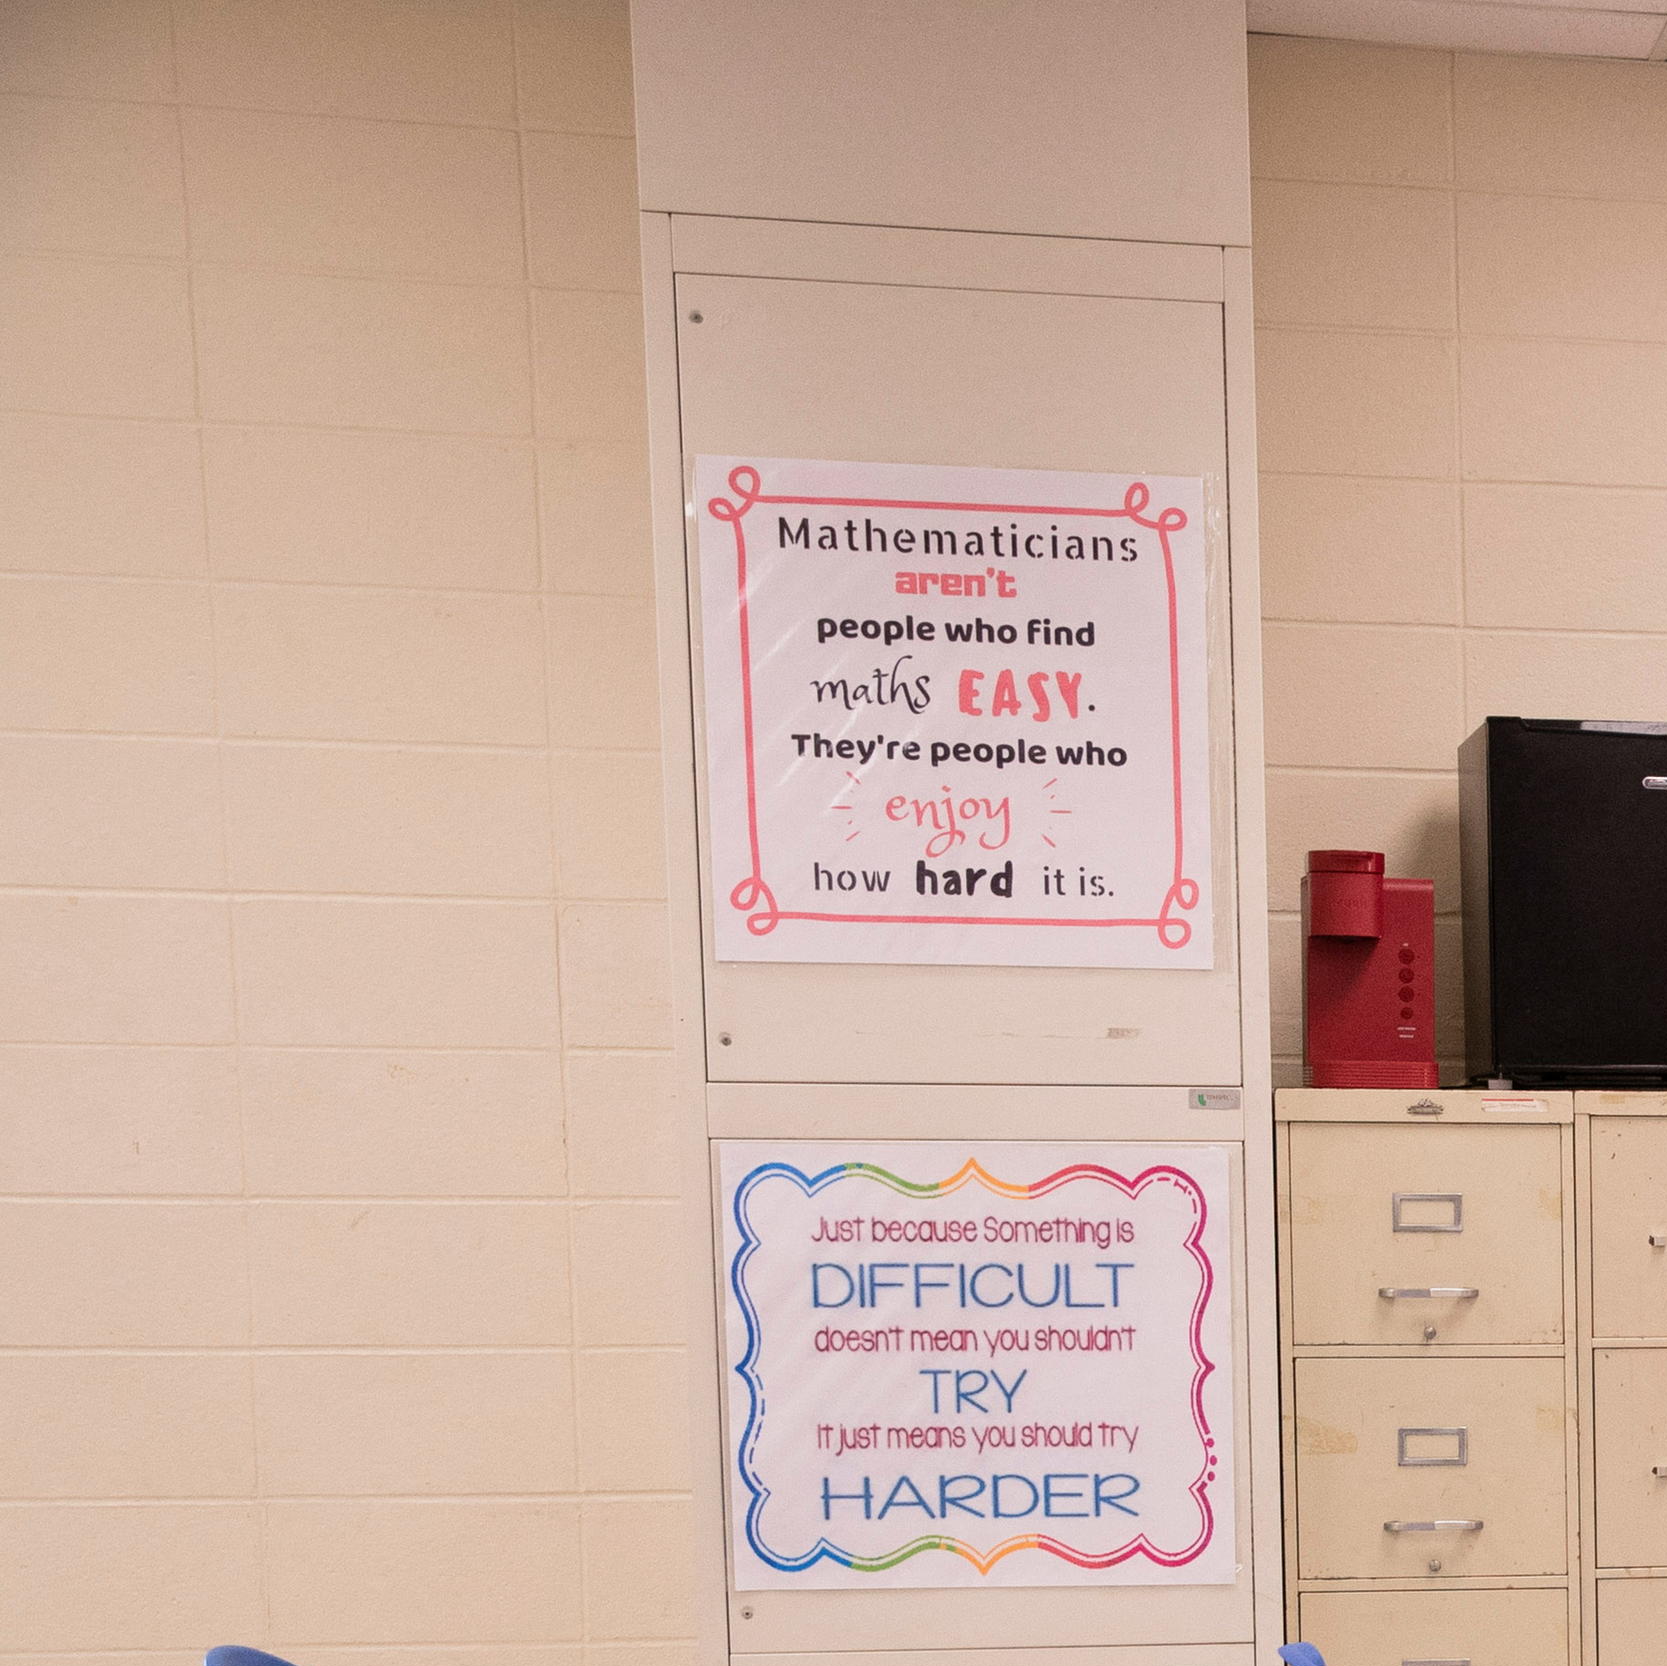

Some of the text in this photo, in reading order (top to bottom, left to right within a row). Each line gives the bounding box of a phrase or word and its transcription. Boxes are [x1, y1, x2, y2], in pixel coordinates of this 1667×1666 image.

[778, 517, 1138, 562] Mathematicians
[895, 567, 1017, 598] aren't
[817, 616, 1096, 646] people who find
[810, 655, 1096, 722] maths EASY.
[791, 734, 1128, 768] They're people who
[885, 786, 1011, 857] enjoy
[813, 860, 1115, 897] how hard it is.
[811, 1216, 1135, 1250] Just because Something is
[811, 1263, 1135, 1308] DIFFICULT
[911, 1329, 978, 1352] mean
[983, 1330, 1029, 1358] you
[919, 1369, 1028, 1414] TRY
[817, 1421, 1139, 1456] It just means you should try
[821, 1474, 1141, 1520] HARDER
